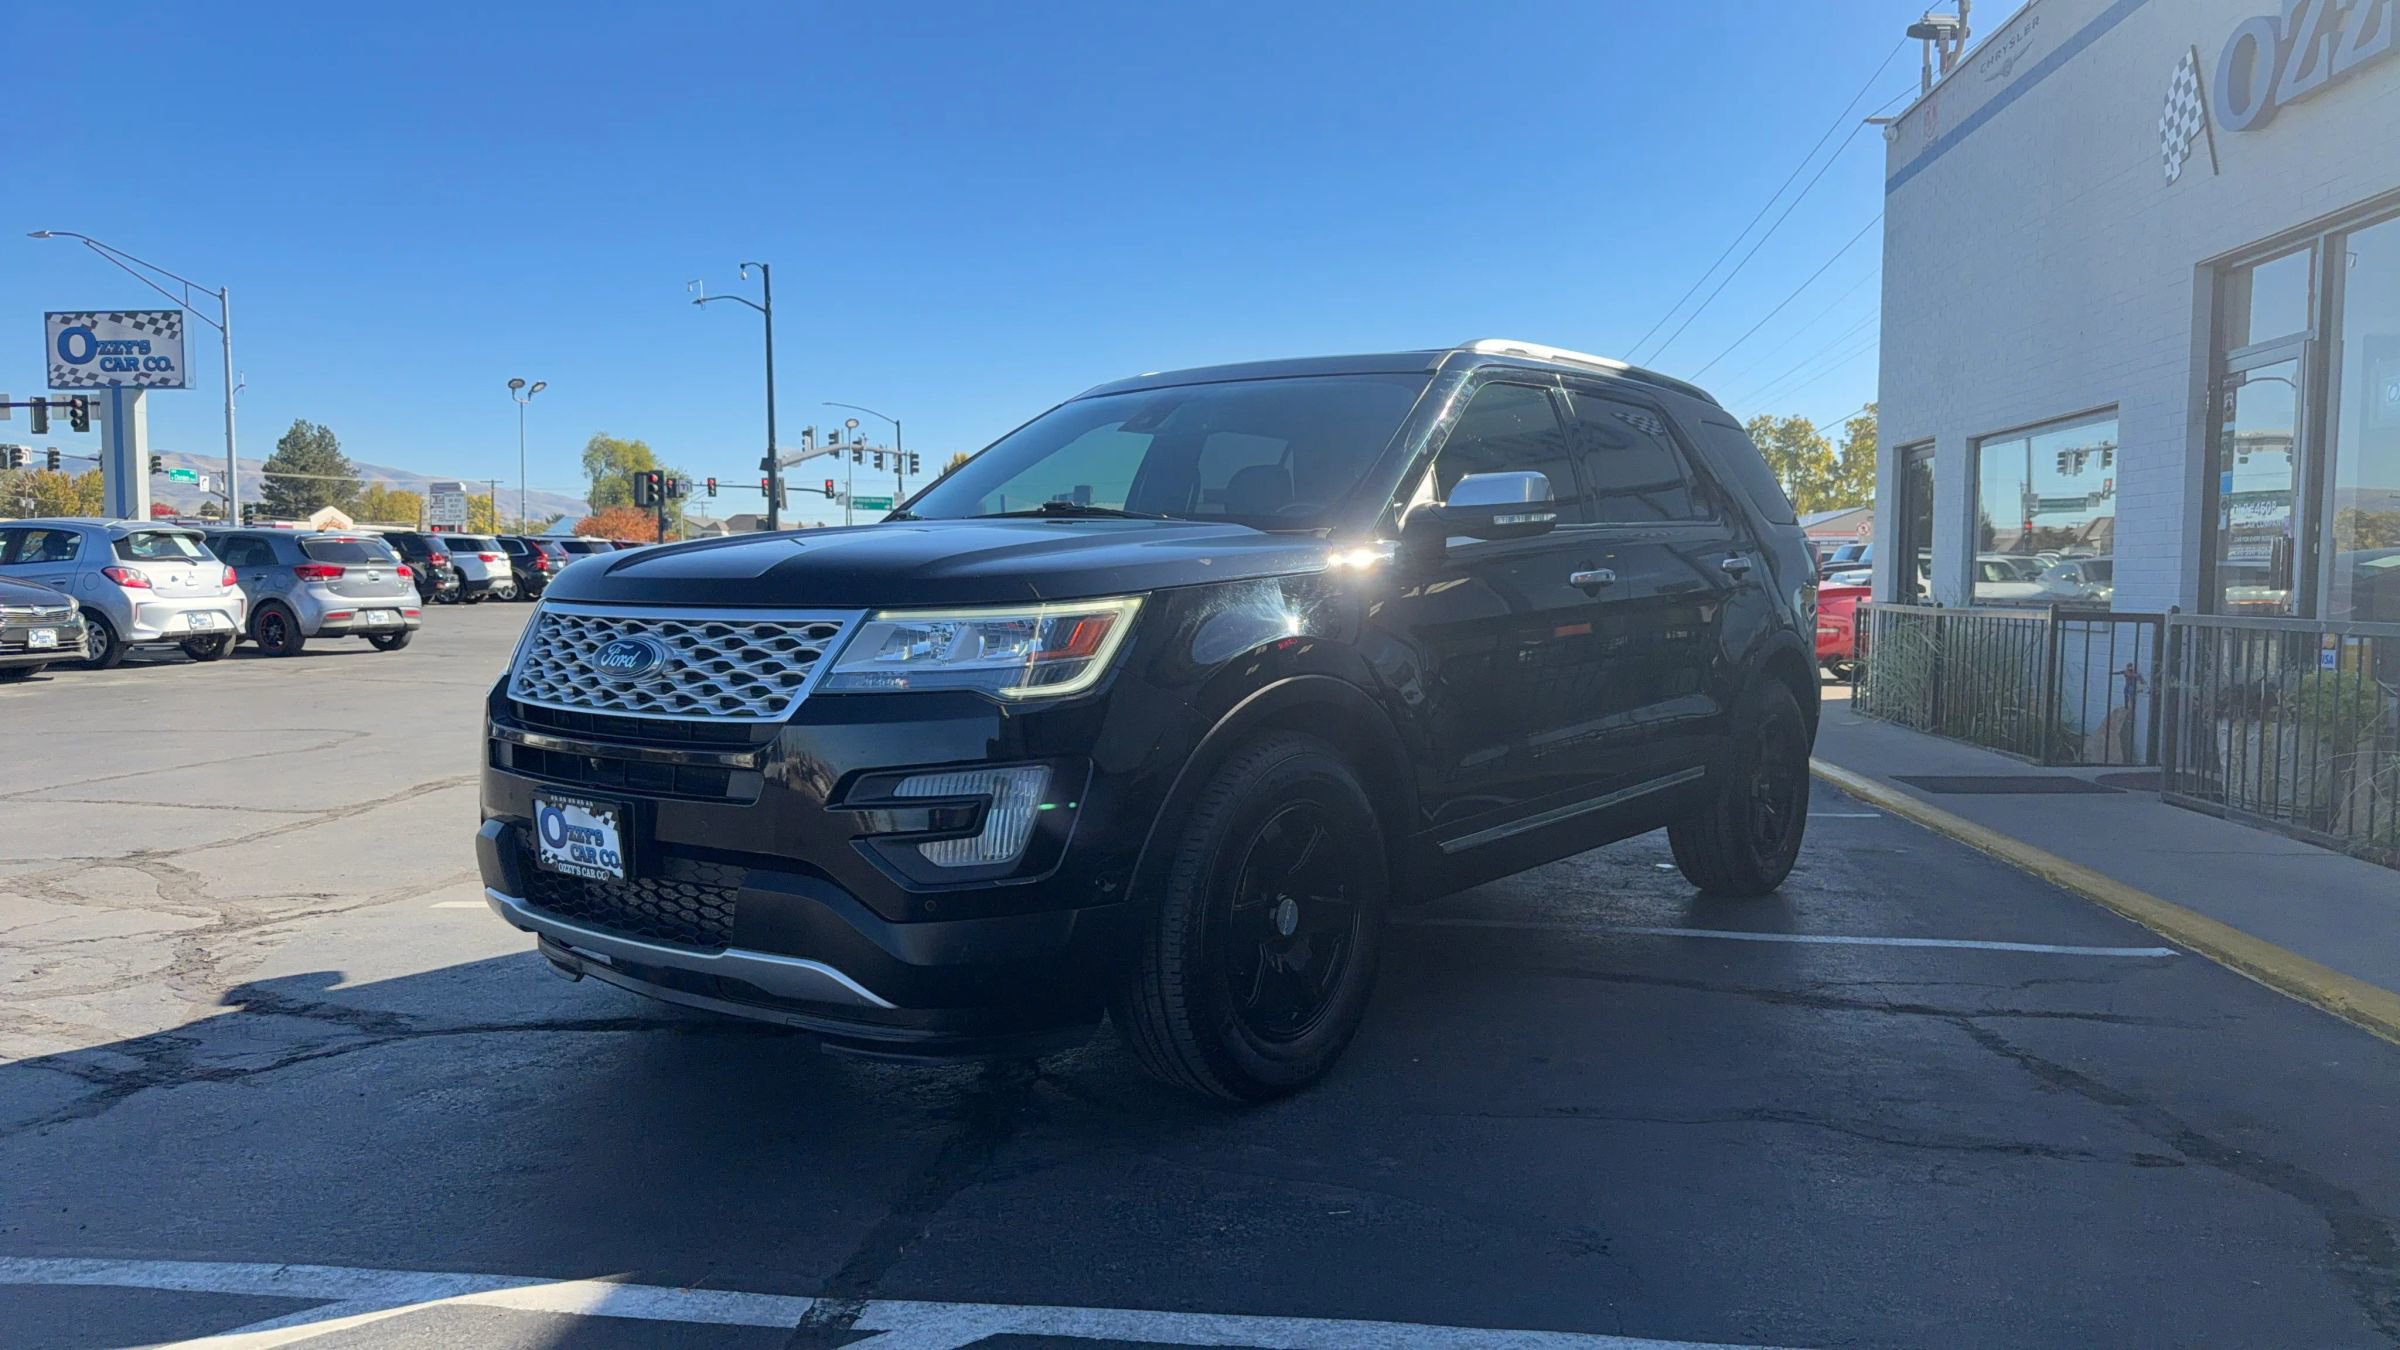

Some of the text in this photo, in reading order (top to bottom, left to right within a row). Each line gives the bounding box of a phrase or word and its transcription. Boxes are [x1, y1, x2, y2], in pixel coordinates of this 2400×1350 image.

[1980, 16, 2040, 74] CHRYSLER
[57, 326, 152, 365] OZZY'S
[100, 356, 175, 372] CAR CO.
[600, 642, 641, 668] Ford
[540, 806, 605, 849] OZZY'S
[570, 843, 598, 864] CAR
[559, 863, 581, 875] OZZY'S
[582, 868, 596, 878] CAR
